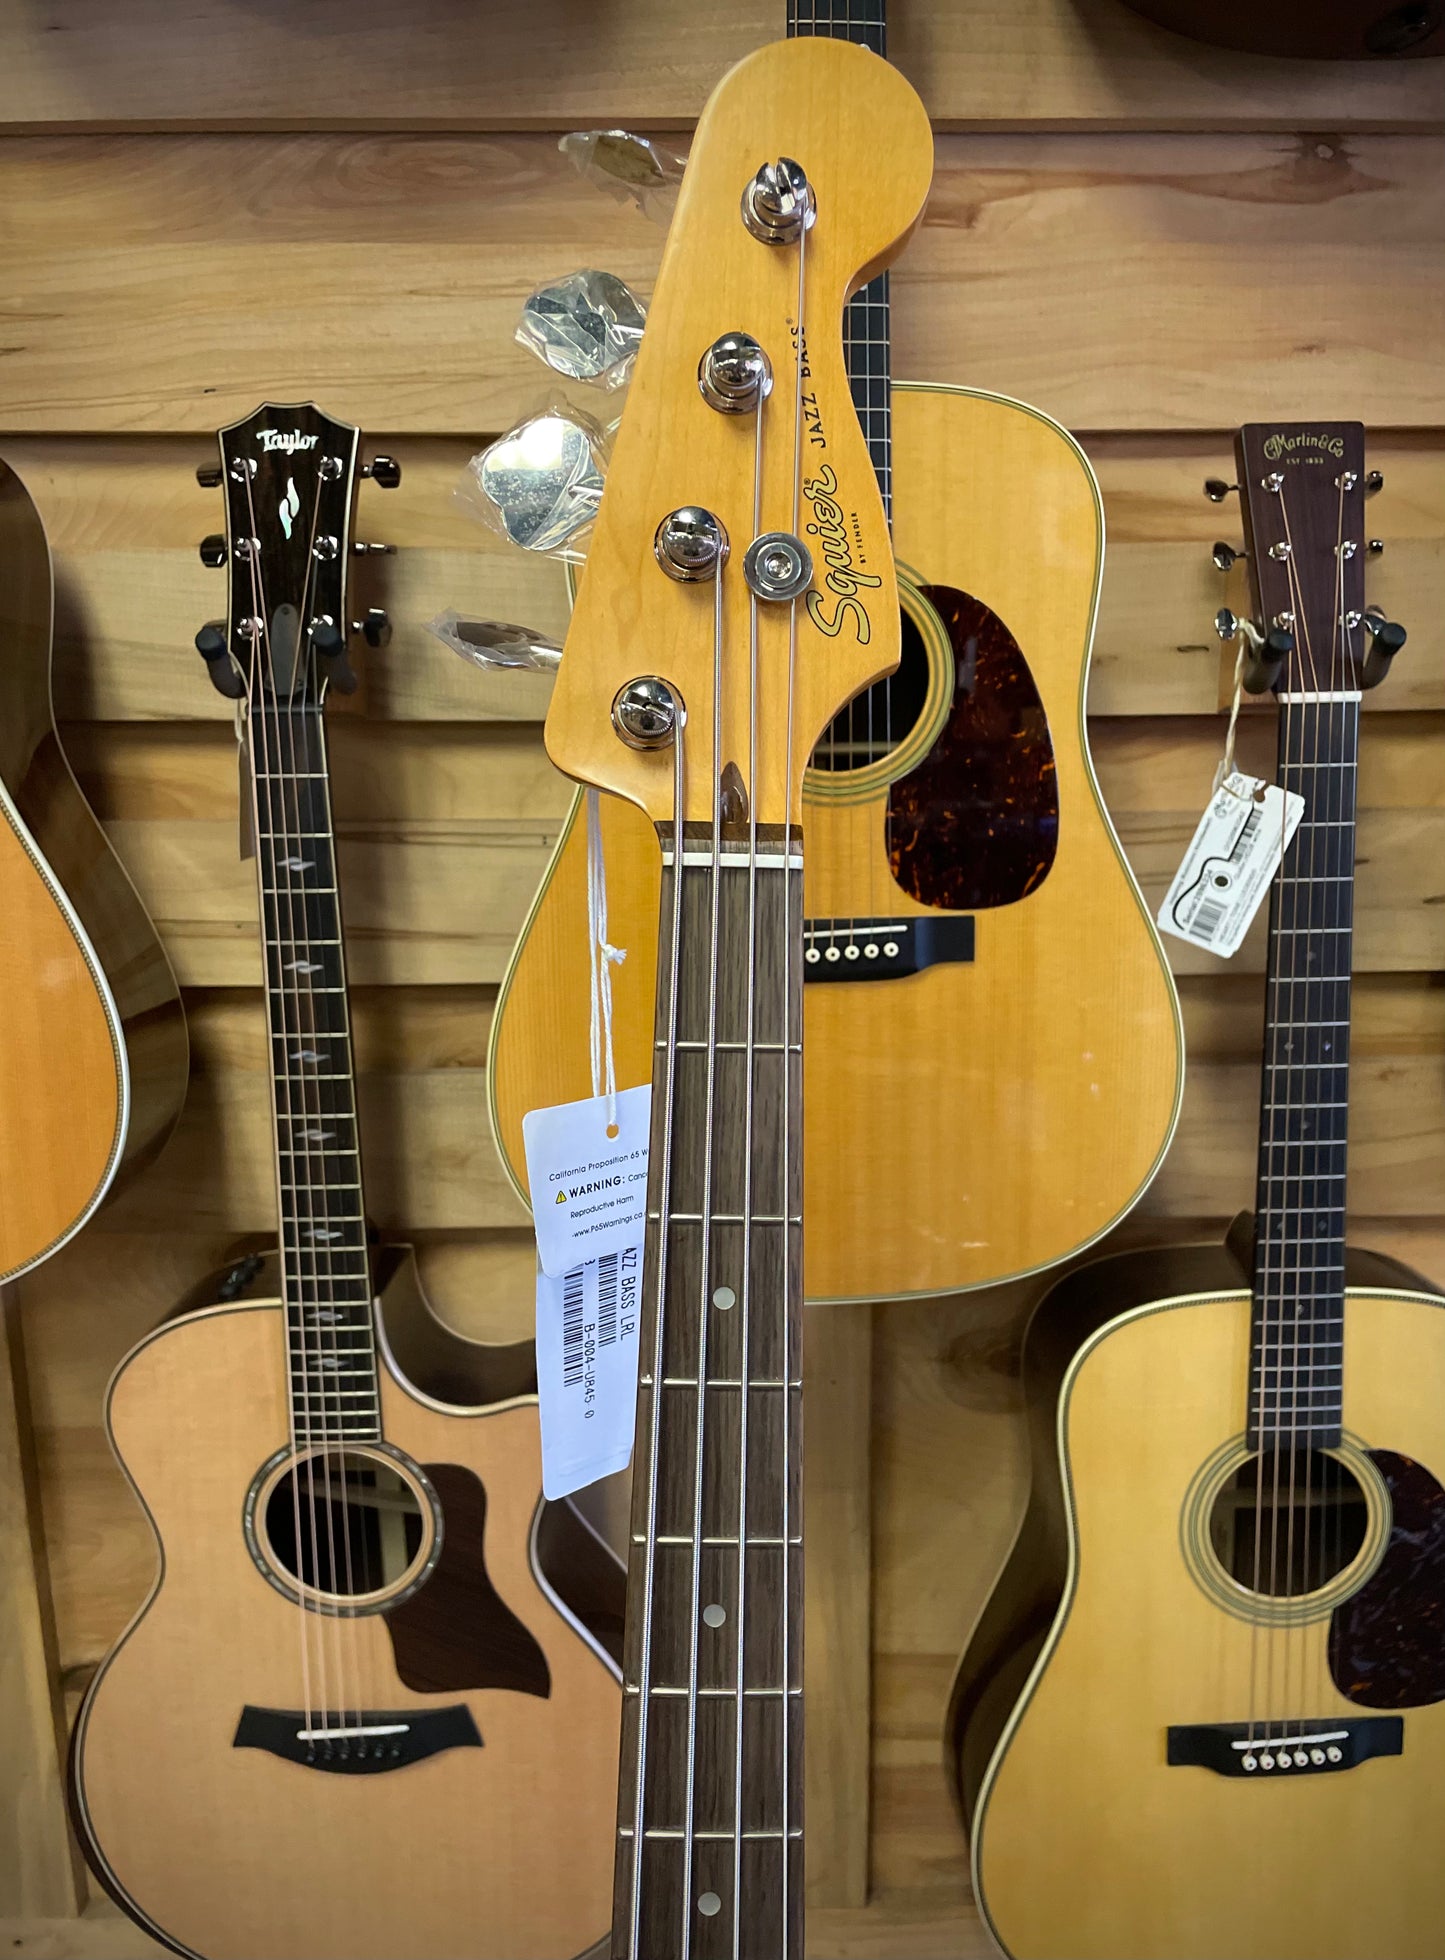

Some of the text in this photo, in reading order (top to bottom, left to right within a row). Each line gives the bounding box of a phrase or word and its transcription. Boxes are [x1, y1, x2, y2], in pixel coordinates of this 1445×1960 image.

[791, 326, 826, 449] JAZZ BASS
[256, 429, 319, 455] Taylor
[804, 464, 882, 645] Squier
[851, 511, 867, 564] BY FENDER
[549, 1166, 586, 1181] California
[588, 1154, 628, 1170] Proposition
[630, 1150, 640, 1160] 65
[569, 1175, 626, 1198] WARNING:
[570, 1195, 634, 1219] Reproductive Harm
[620, 1247, 637, 1341] AZZ BASS LRL
